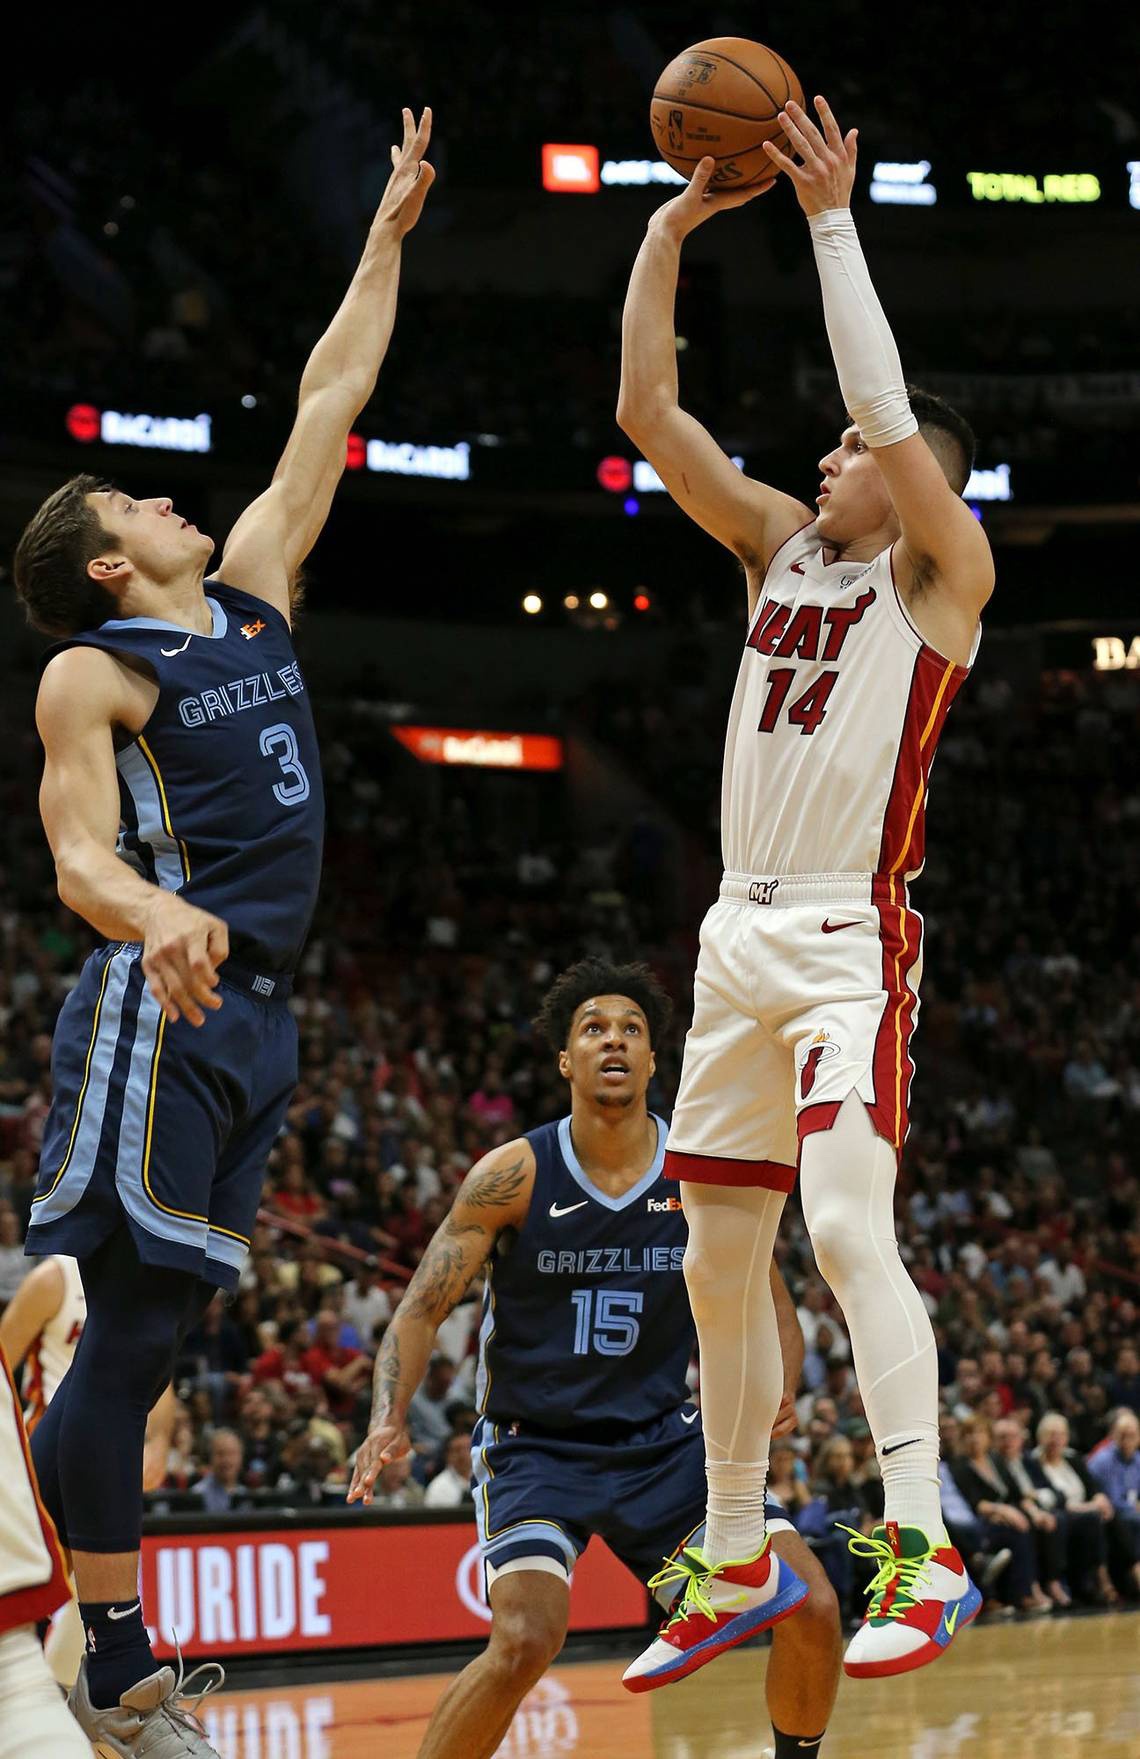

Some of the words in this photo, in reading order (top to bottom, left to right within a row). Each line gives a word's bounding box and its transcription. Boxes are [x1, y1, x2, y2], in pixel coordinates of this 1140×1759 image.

[757, 668, 840, 735] 14
[259, 723, 310, 806] 3
[537, 1247, 687, 1274] GRIZZLIES
[571, 1289, 644, 1356] 15
[140, 1541, 331, 1648] URIDE
